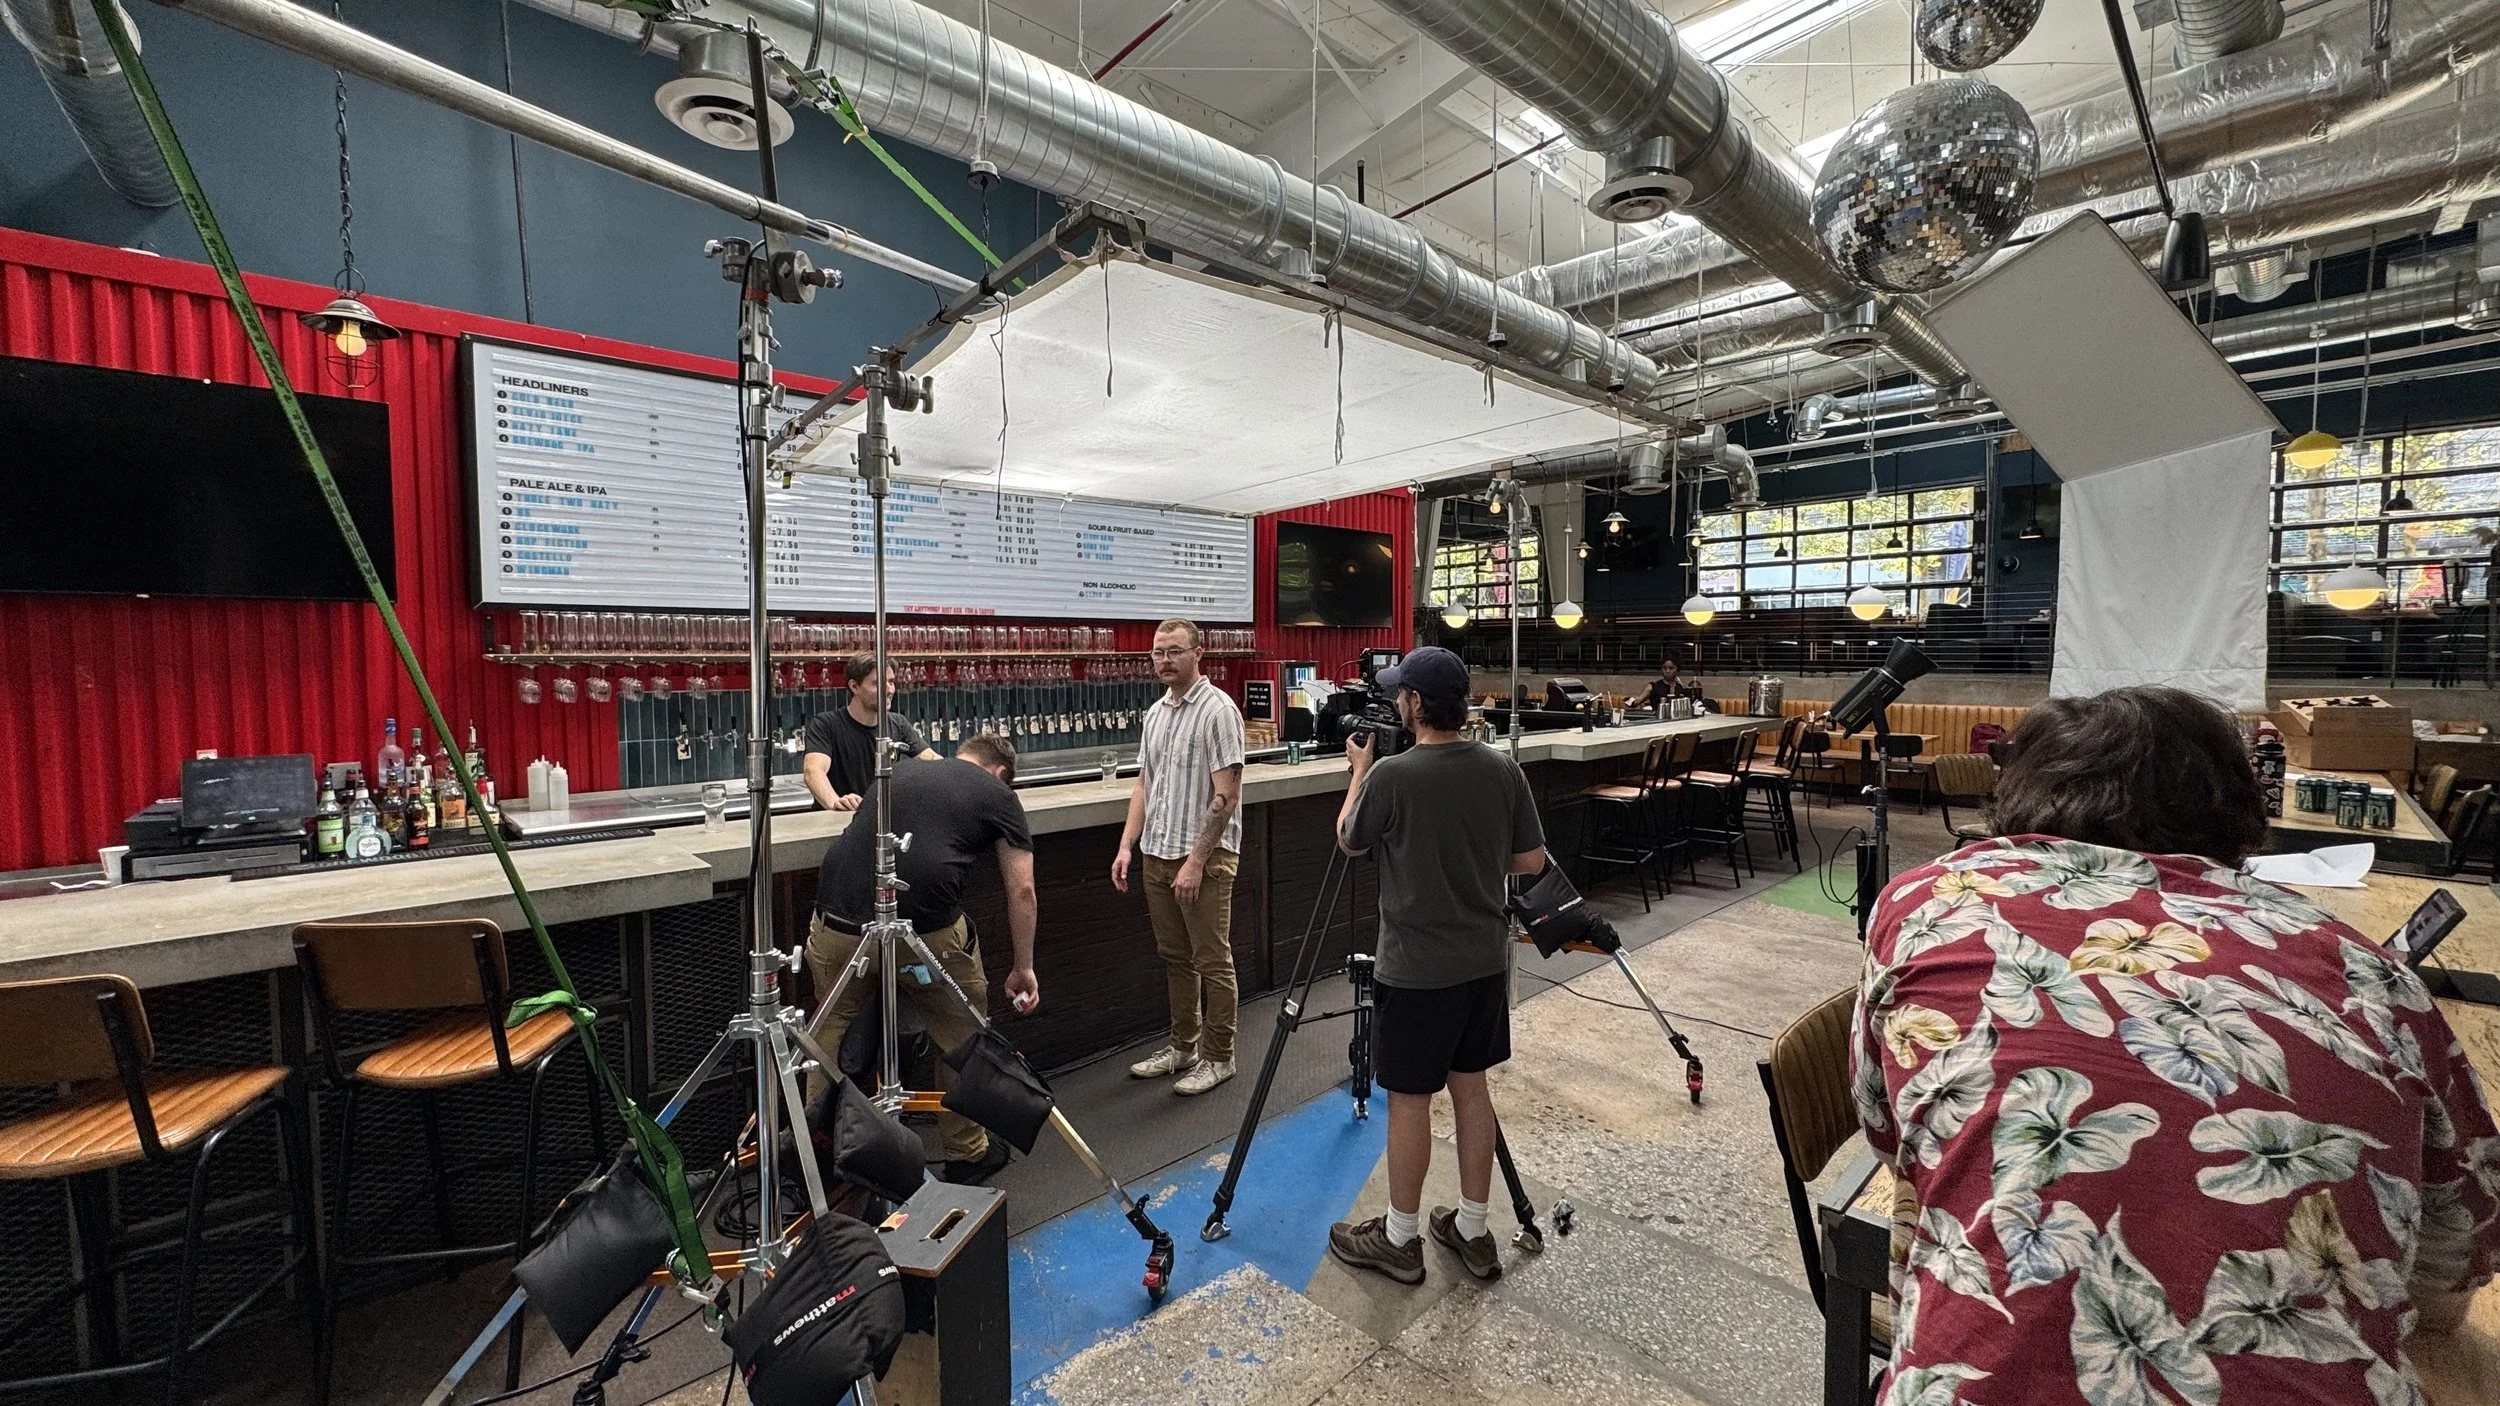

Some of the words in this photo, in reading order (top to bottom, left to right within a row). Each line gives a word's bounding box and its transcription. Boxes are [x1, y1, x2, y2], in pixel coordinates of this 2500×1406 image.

[502, 376, 589, 397] HEADLINERS
[510, 479, 545, 490] PALE
[547, 482, 573, 493] ALE
[575, 484, 585, 493] &
[587, 486, 608, 495] IPA
[320, 476, 379, 584] KEEPER
[1088, 524, 1106, 532] SOUR
[1083, 581, 1098, 589] NON
[1099, 582, 1137, 590] ALCOHOLIC
[2340, 804, 2363, 827] IPA
[2367, 803, 2390, 826] IPA
[773, 1284, 856, 1347] matthews
